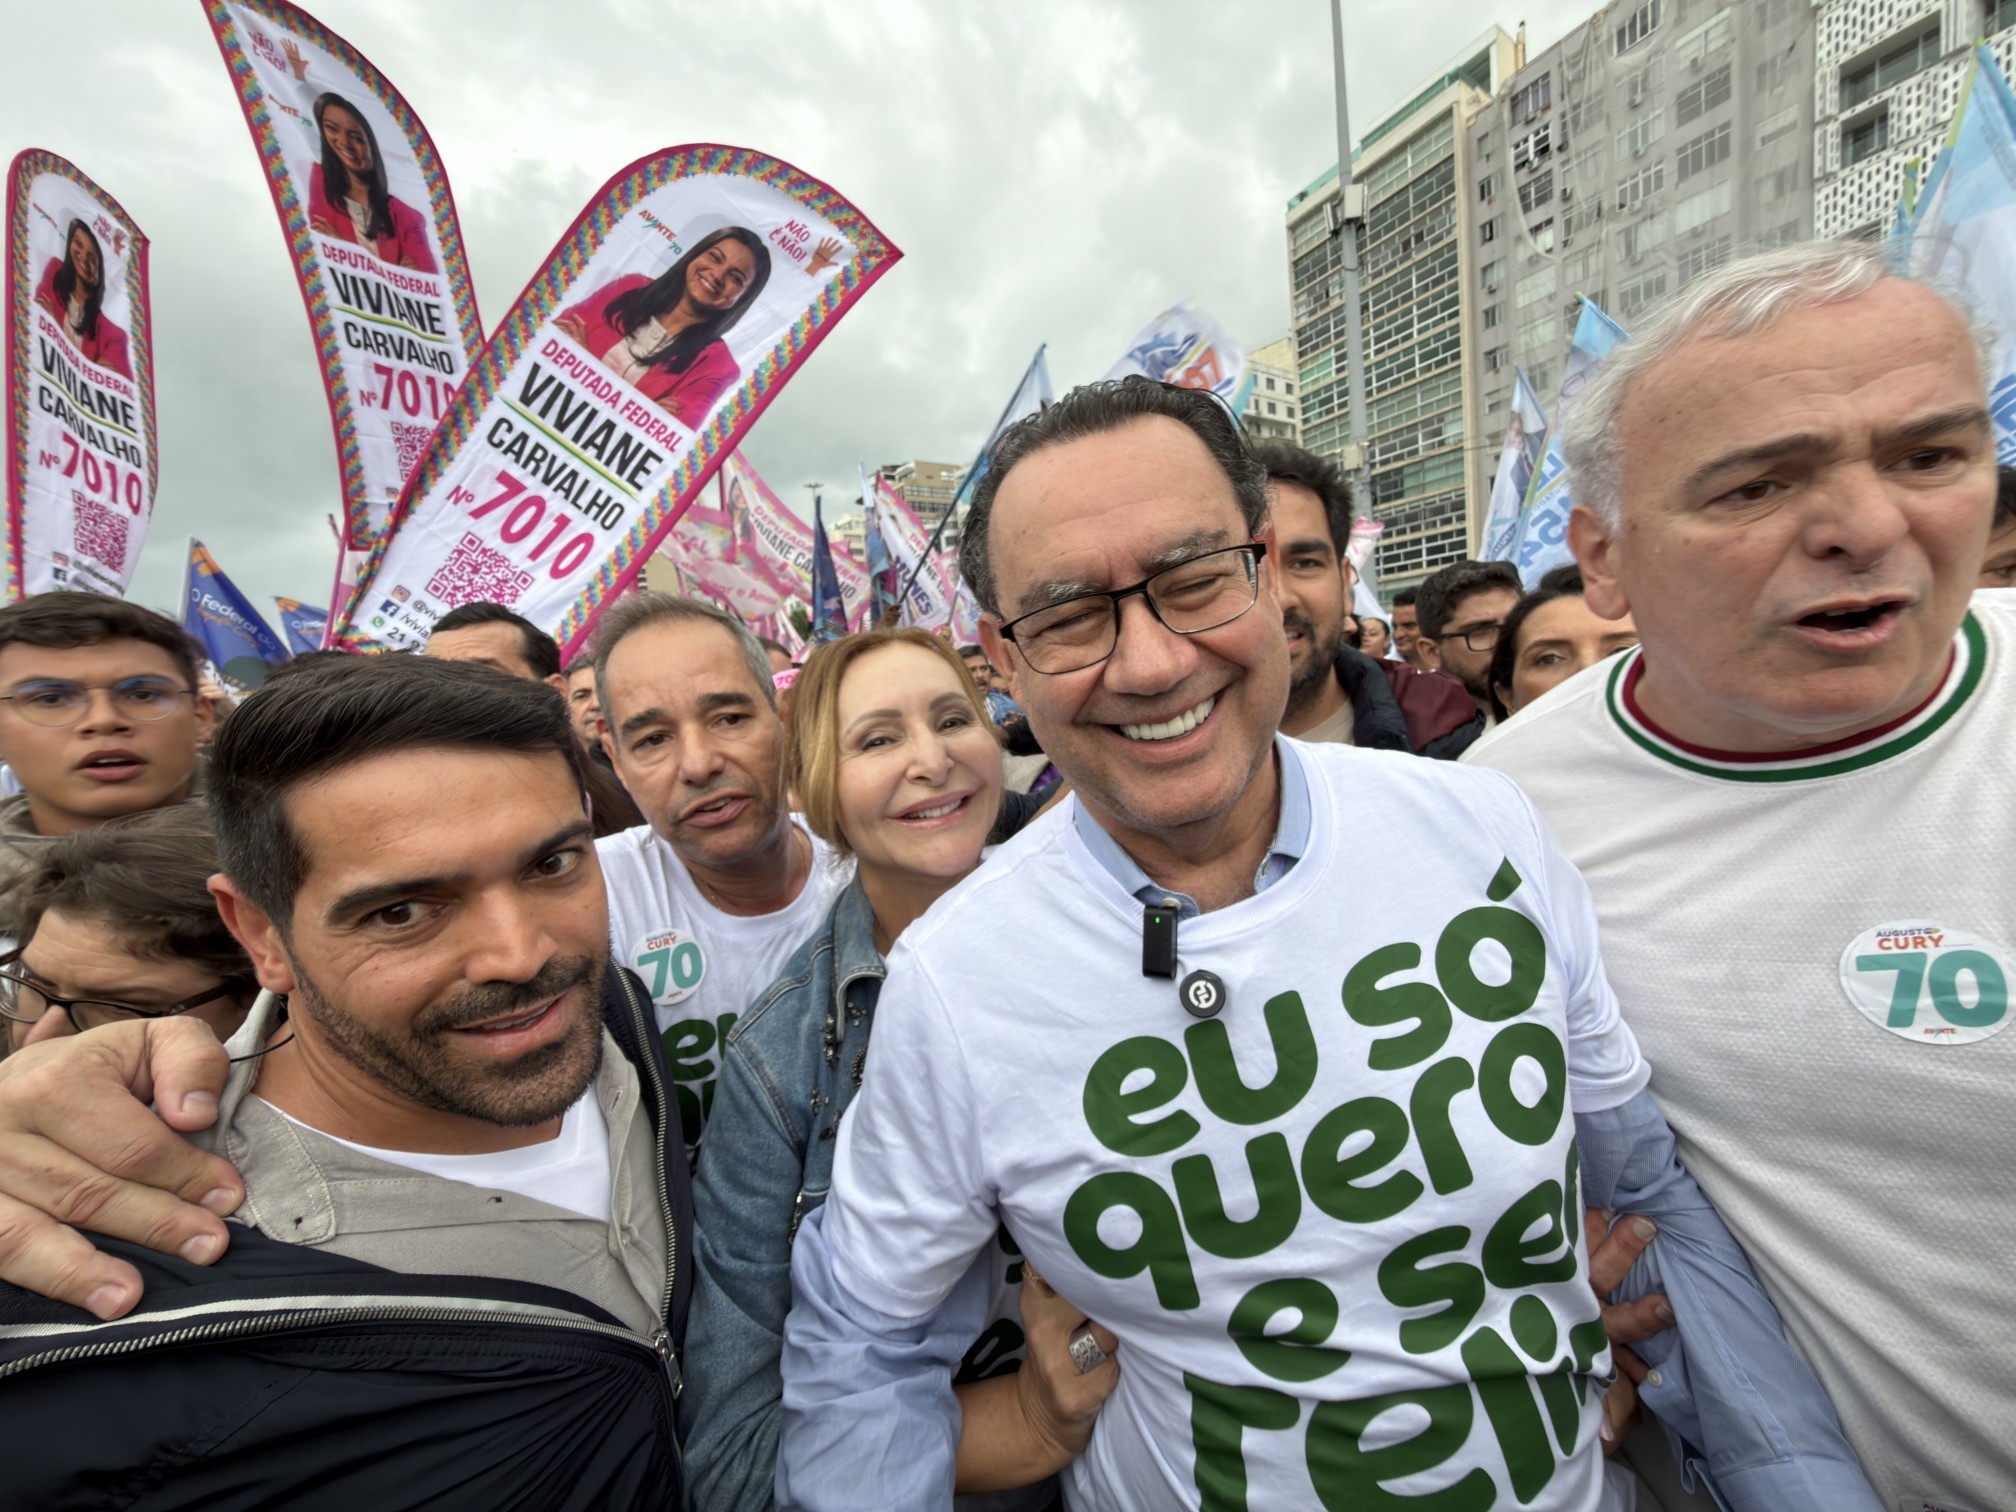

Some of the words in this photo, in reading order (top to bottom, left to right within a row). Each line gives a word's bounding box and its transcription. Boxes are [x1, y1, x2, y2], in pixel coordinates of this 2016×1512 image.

[639, 209, 677, 242] AVANTE
[669, 241, 682, 255] 70
[769, 228, 780, 242] É
[777, 235, 807, 263] NÃO!
[785, 219, 811, 243] NÃO
[321, 242, 386, 279] DEPUTADA
[386, 270, 441, 298] FEDERAL
[328, 266, 446, 336] VIVIANE
[39, 315, 80, 371] DEPUTADA
[82, 362, 135, 402] FEDERAL
[40, 335, 138, 434] VIVIANE
[343, 321, 455, 376] CARVALHO
[39, 385, 142, 469] CARVALHO
[518, 361, 664, 492] VIVIANE
[541, 338, 623, 406] DEPUTADA
[619, 399, 683, 453] FEDERAL
[62, 431, 142, 516] 7010
[486, 416, 625, 531] CARVALHO
[467, 470, 595, 580] 7010
[202, 594, 258, 635] Federal
[387, 627, 406, 643] 21
[647, 934, 677, 950] CURY
[1875, 928, 1936, 938] AUGUSTO
[1877, 935, 1944, 951] CURY
[637, 942, 703, 999] 70
[1082, 990, 1318, 1157] eu
[1341, 855, 1546, 1072] só
[1855, 949, 2008, 1028] 70
[1063, 1022, 1567, 1311] quero
[1227, 1277, 1352, 1382] e
